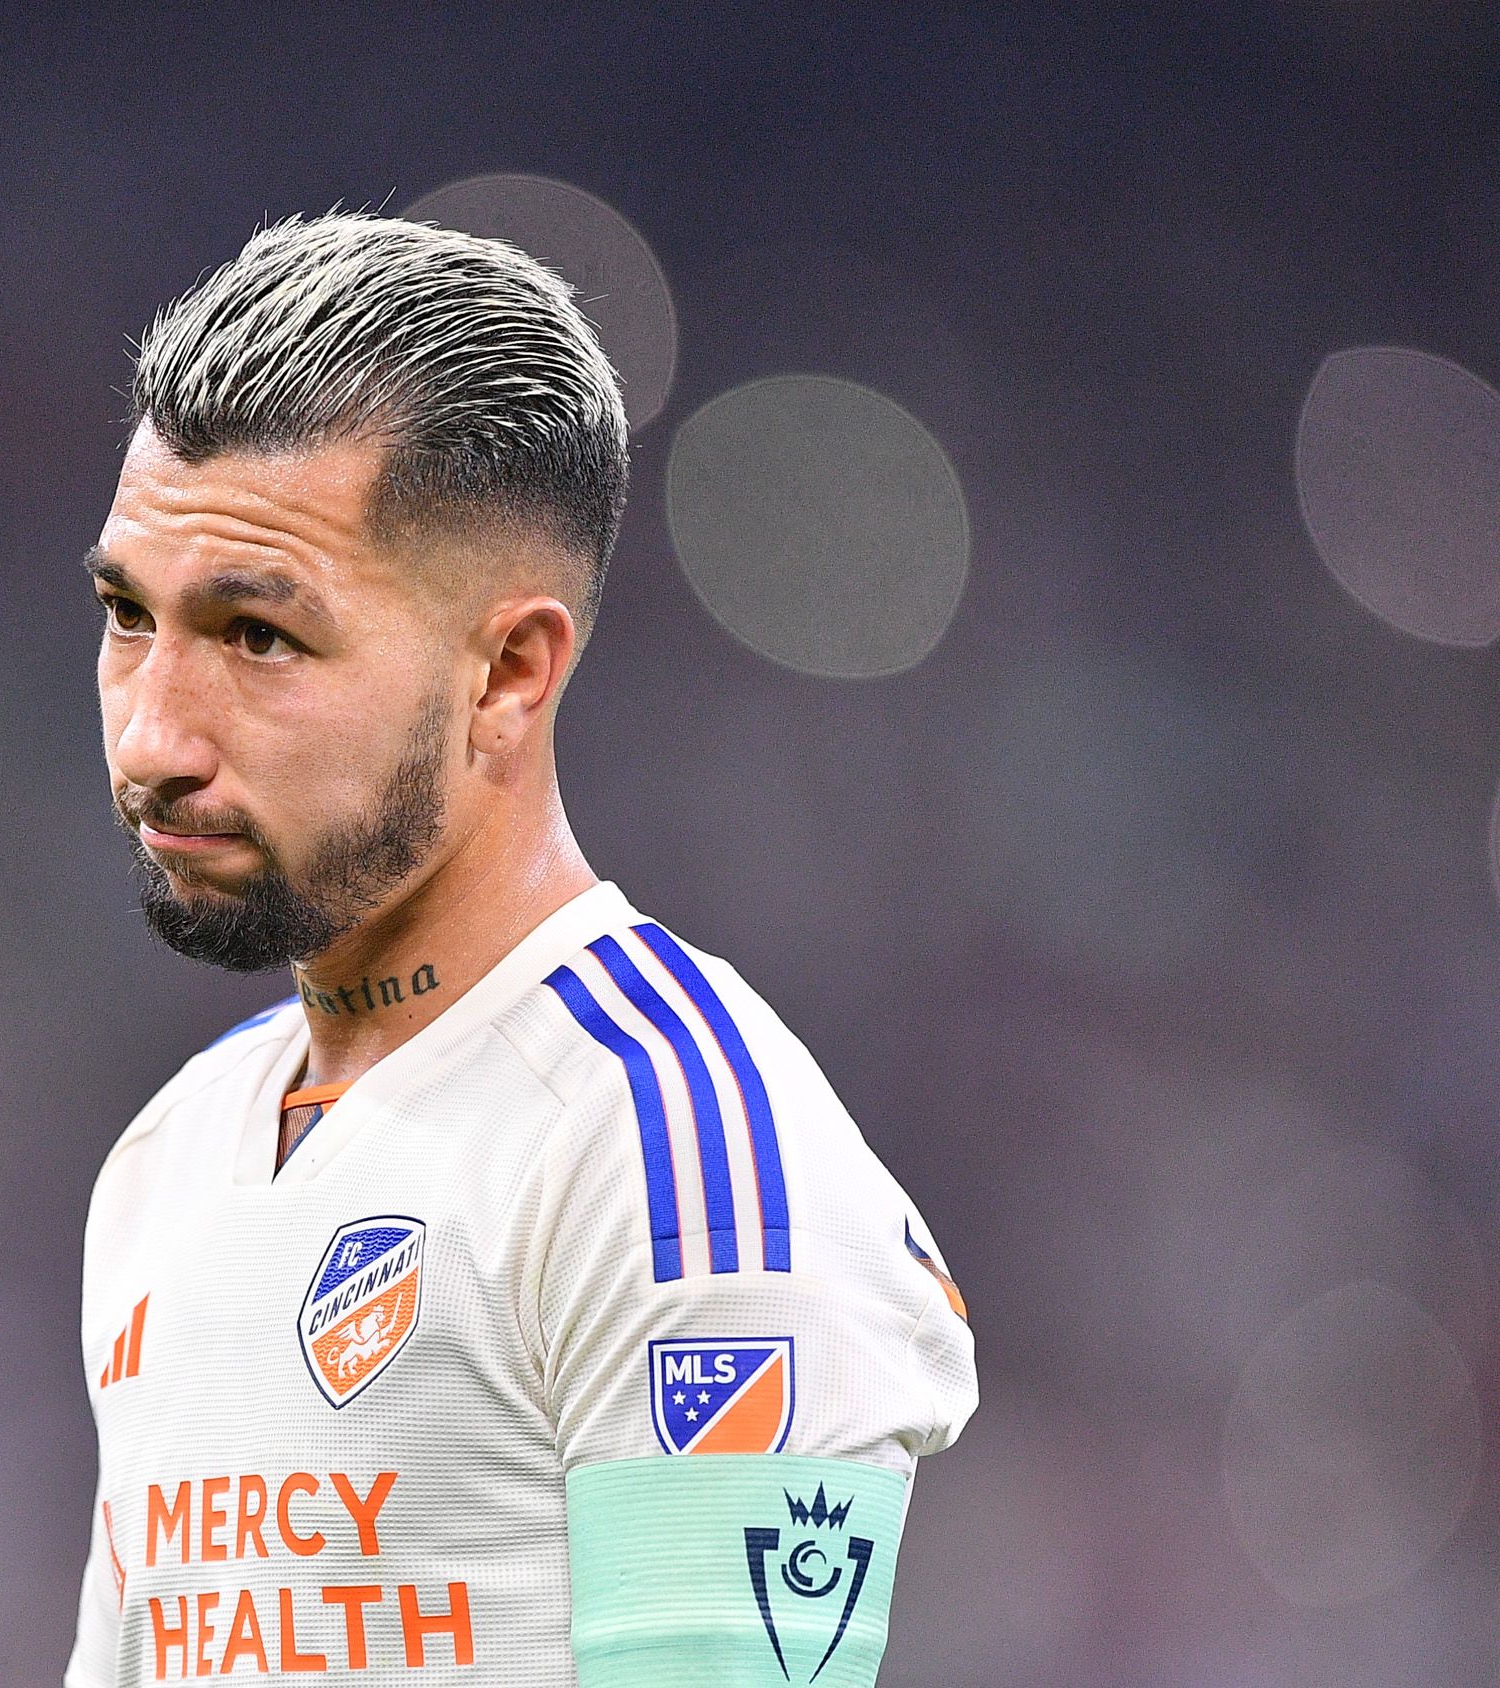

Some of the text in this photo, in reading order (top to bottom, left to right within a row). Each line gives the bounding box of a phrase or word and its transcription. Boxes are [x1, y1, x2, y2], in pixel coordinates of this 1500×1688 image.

[308, 1234, 421, 1336] CINCINNATI
[337, 1241, 363, 1270] FC
[665, 1353, 736, 1385] MLS
[145, 1472, 398, 1567] MERCY
[148, 1582, 474, 1680] HEALTH
